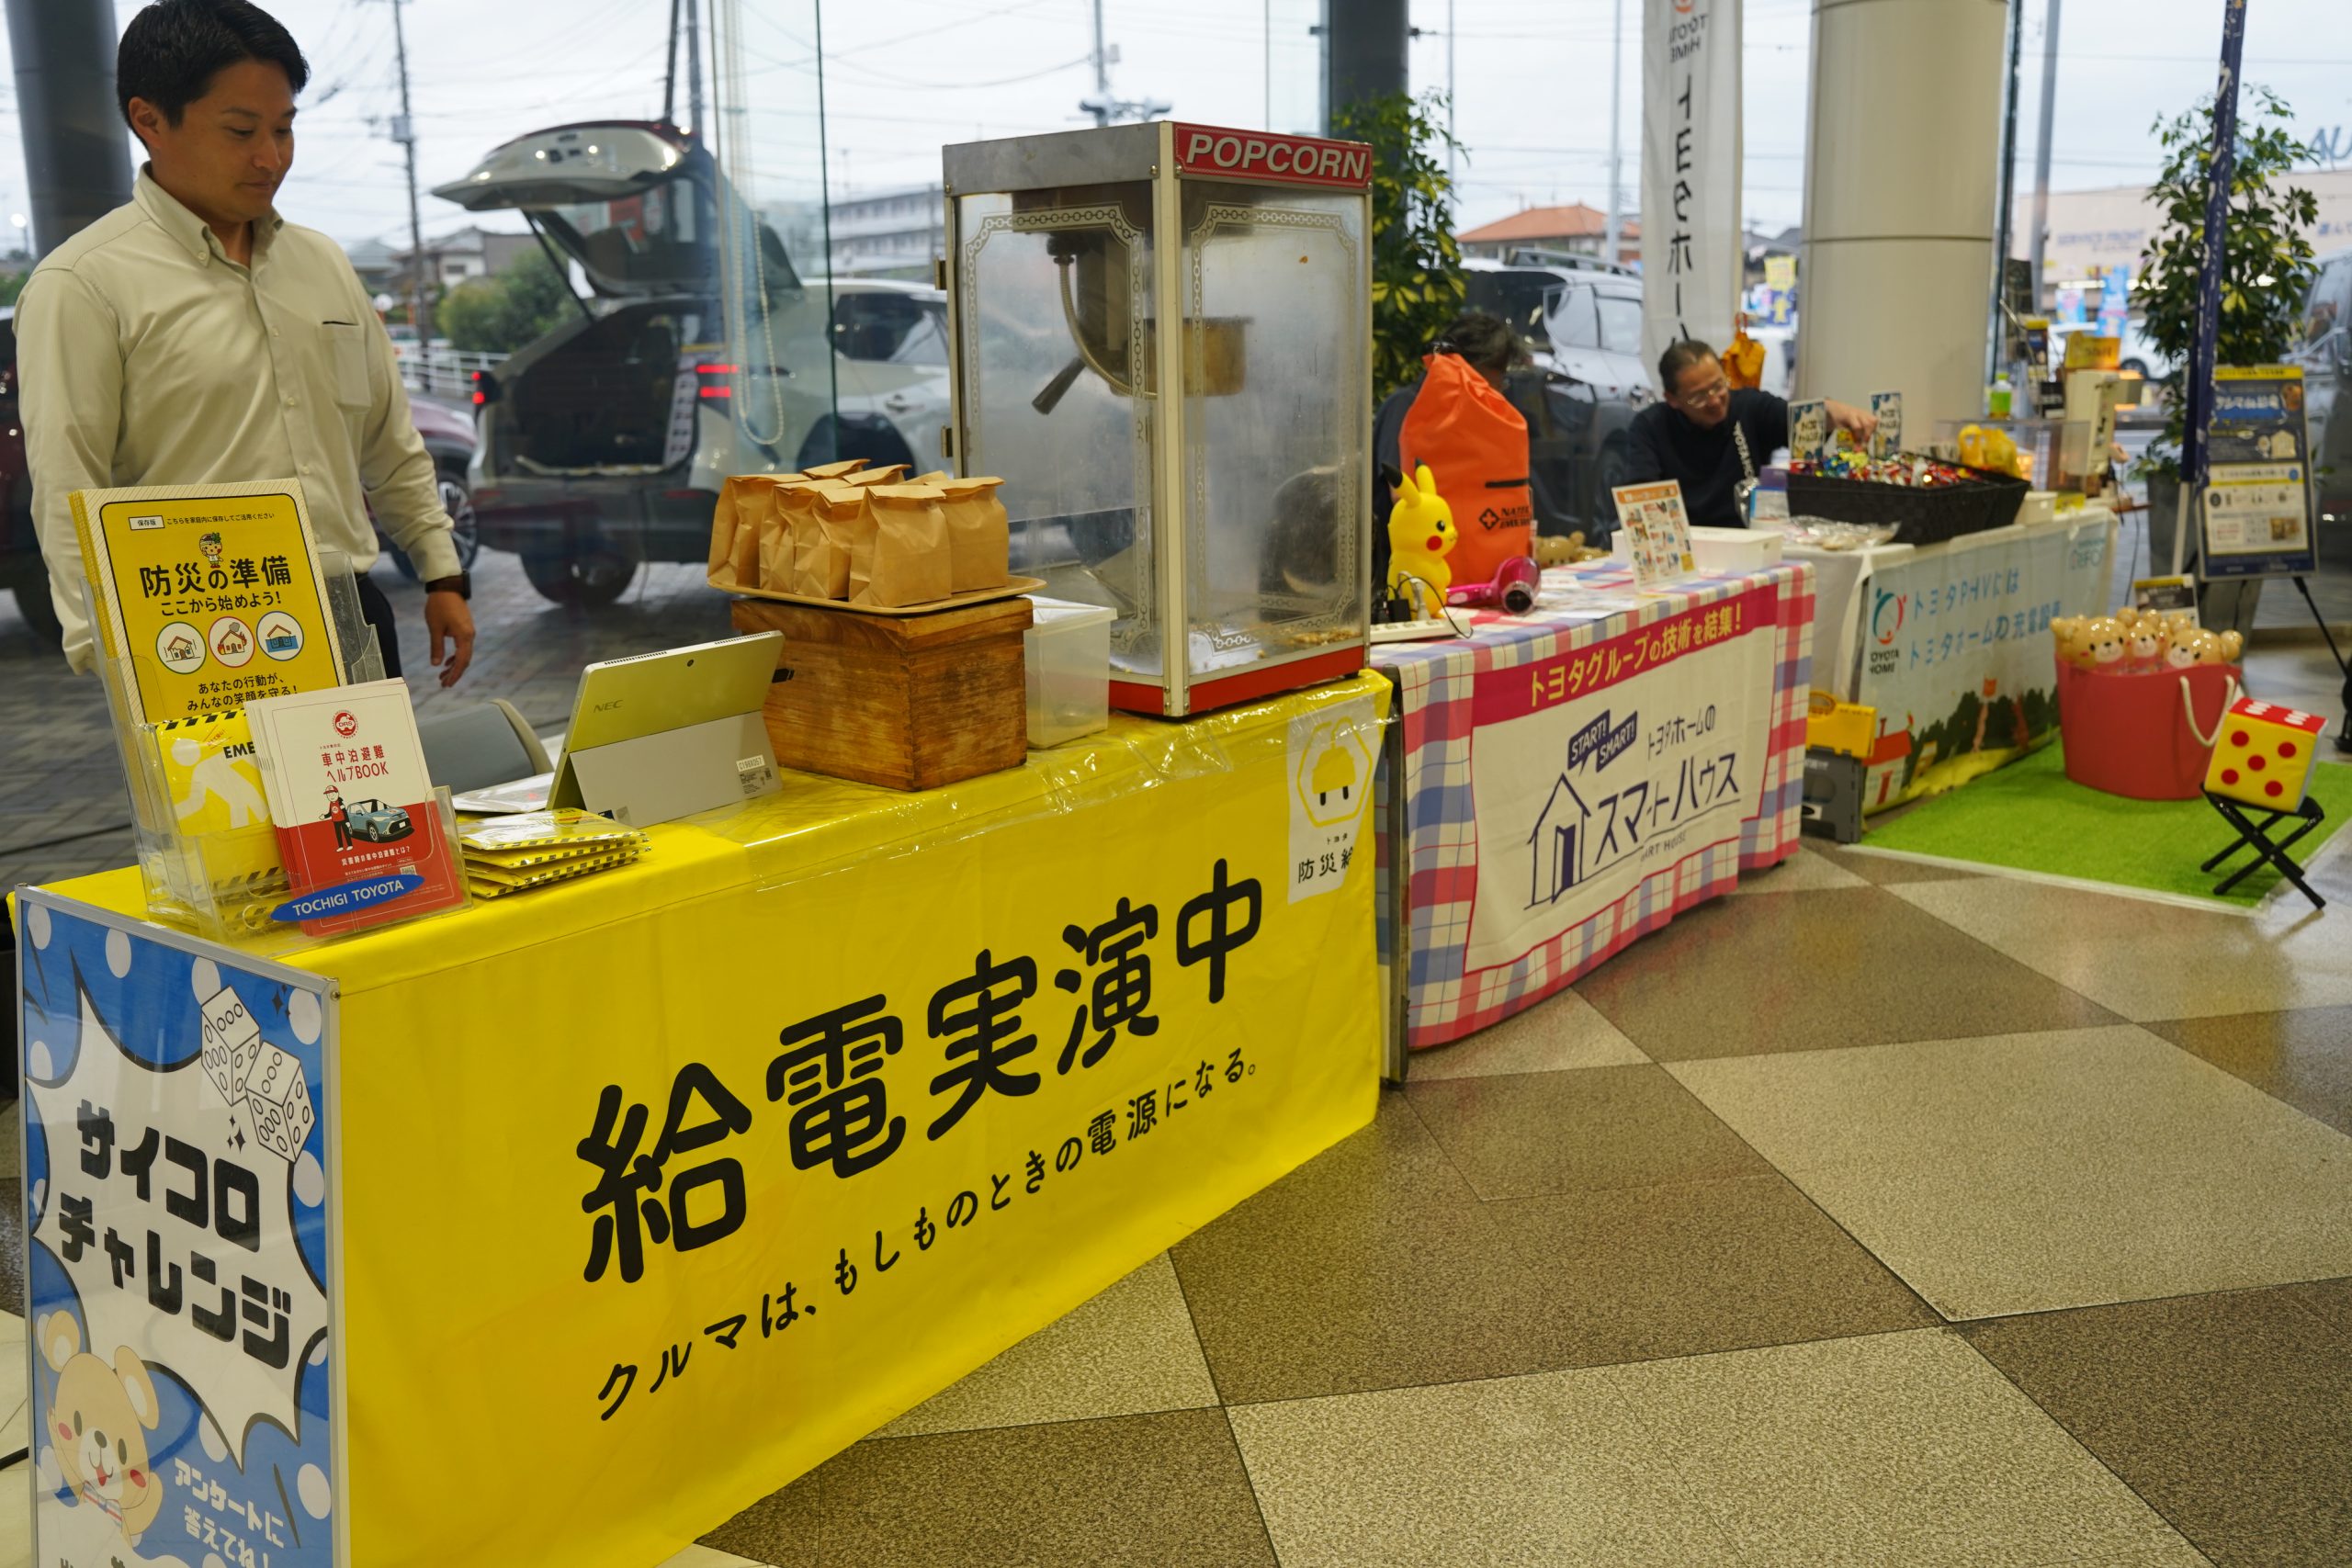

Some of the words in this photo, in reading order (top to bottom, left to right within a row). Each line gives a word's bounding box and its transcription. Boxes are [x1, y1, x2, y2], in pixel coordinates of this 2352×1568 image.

[1186, 133, 1367, 180] POPCORN
[139, 555, 291, 598] 防災の準備
[161, 591, 282, 616] ここから始めよう!
[1532, 602, 1742, 707] トヨタグループの技術を結集!
[198, 672, 284, 695] あなたの行動が、
[593, 699, 624, 714] NEC
[1571, 717, 1607, 762] START!
[1599, 720, 1635, 764] SMART!
[1647, 704, 1716, 762] トヨタホームの
[321, 744, 385, 767] 車中泊避難
[326, 761, 390, 783] ヘルプBOOK
[292, 892, 348, 917] TOCHIGI
[351, 879, 405, 903] TOYOTA
[576, 857, 1263, 1284] 給電実演中
[77, 1099, 260, 1253] サイコロ
[59, 1191, 291, 1370] チャレンジ
[175, 1457, 285, 1549] アンケートに
